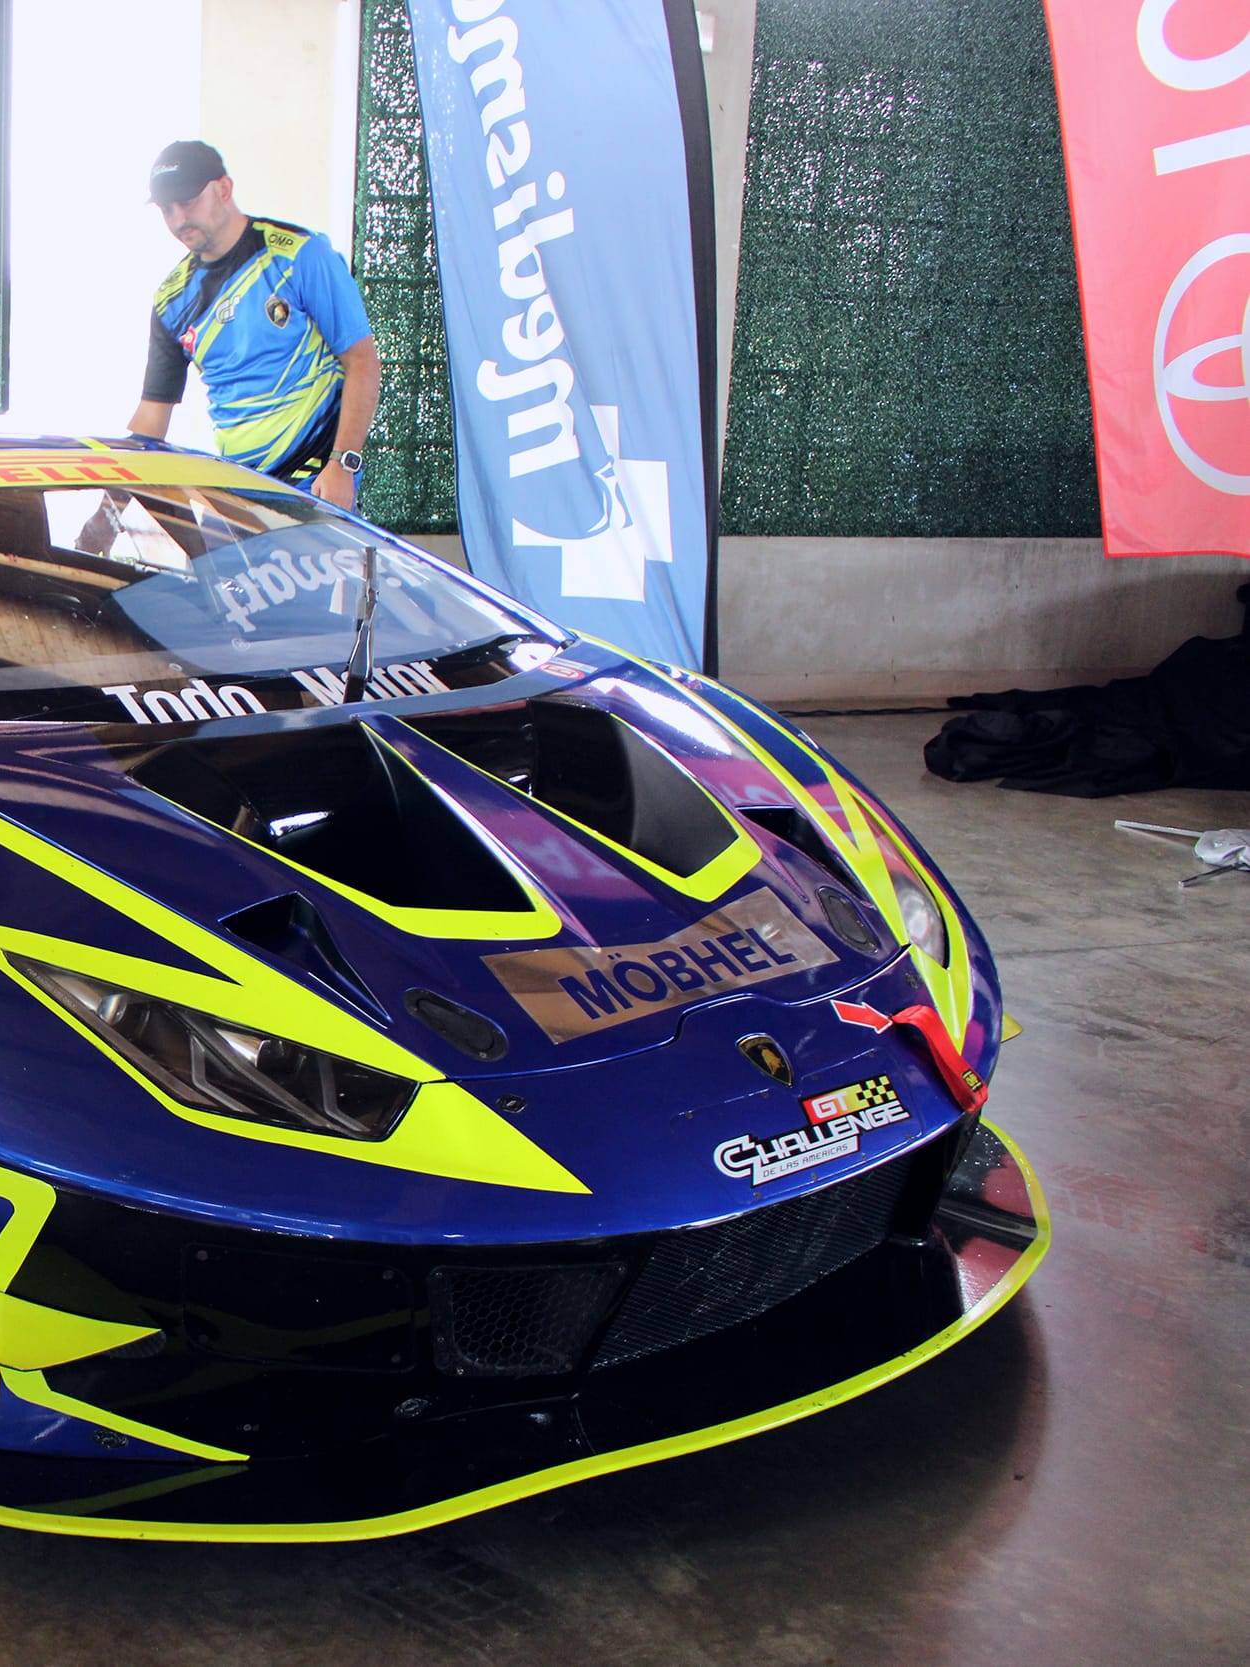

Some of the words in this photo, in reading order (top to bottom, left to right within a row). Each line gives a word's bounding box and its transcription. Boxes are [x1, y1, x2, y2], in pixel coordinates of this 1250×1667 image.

[269, 233, 294, 248] OMP
[100, 678, 268, 725] Todo
[557, 928, 798, 1020] MÖBHEL
[811, 1090, 849, 1119] GT
[713, 1100, 910, 1182] CHALLENGE
[762, 1167, 777, 1179] DE
[779, 1160, 800, 1172] LAS
[802, 1143, 848, 1166] AMERICAS
